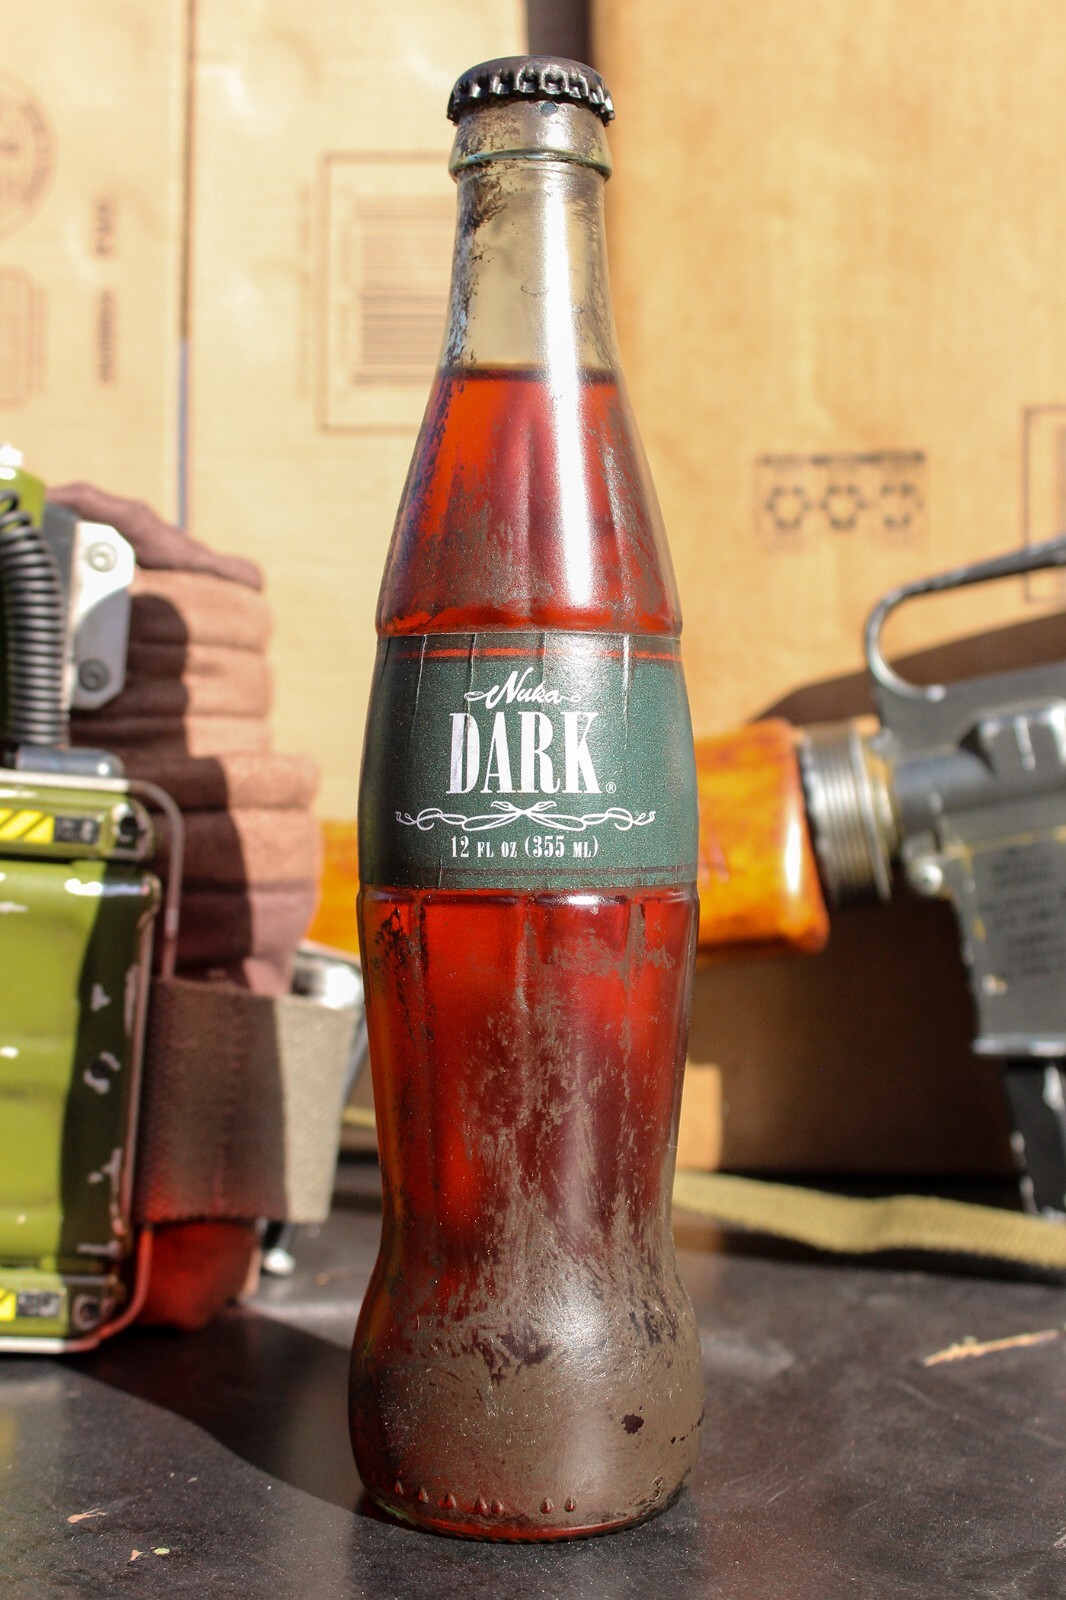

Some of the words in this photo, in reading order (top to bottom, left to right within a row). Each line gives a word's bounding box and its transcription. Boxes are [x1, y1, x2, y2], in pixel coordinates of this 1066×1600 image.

[463, 667, 582, 710] Nuka
[451, 835, 470, 858] 12
[477, 841, 494, 858] FL
[501, 841, 518, 858] OZ
[524, 835, 565, 858] (355
[572, 835, 599, 858] ML)
